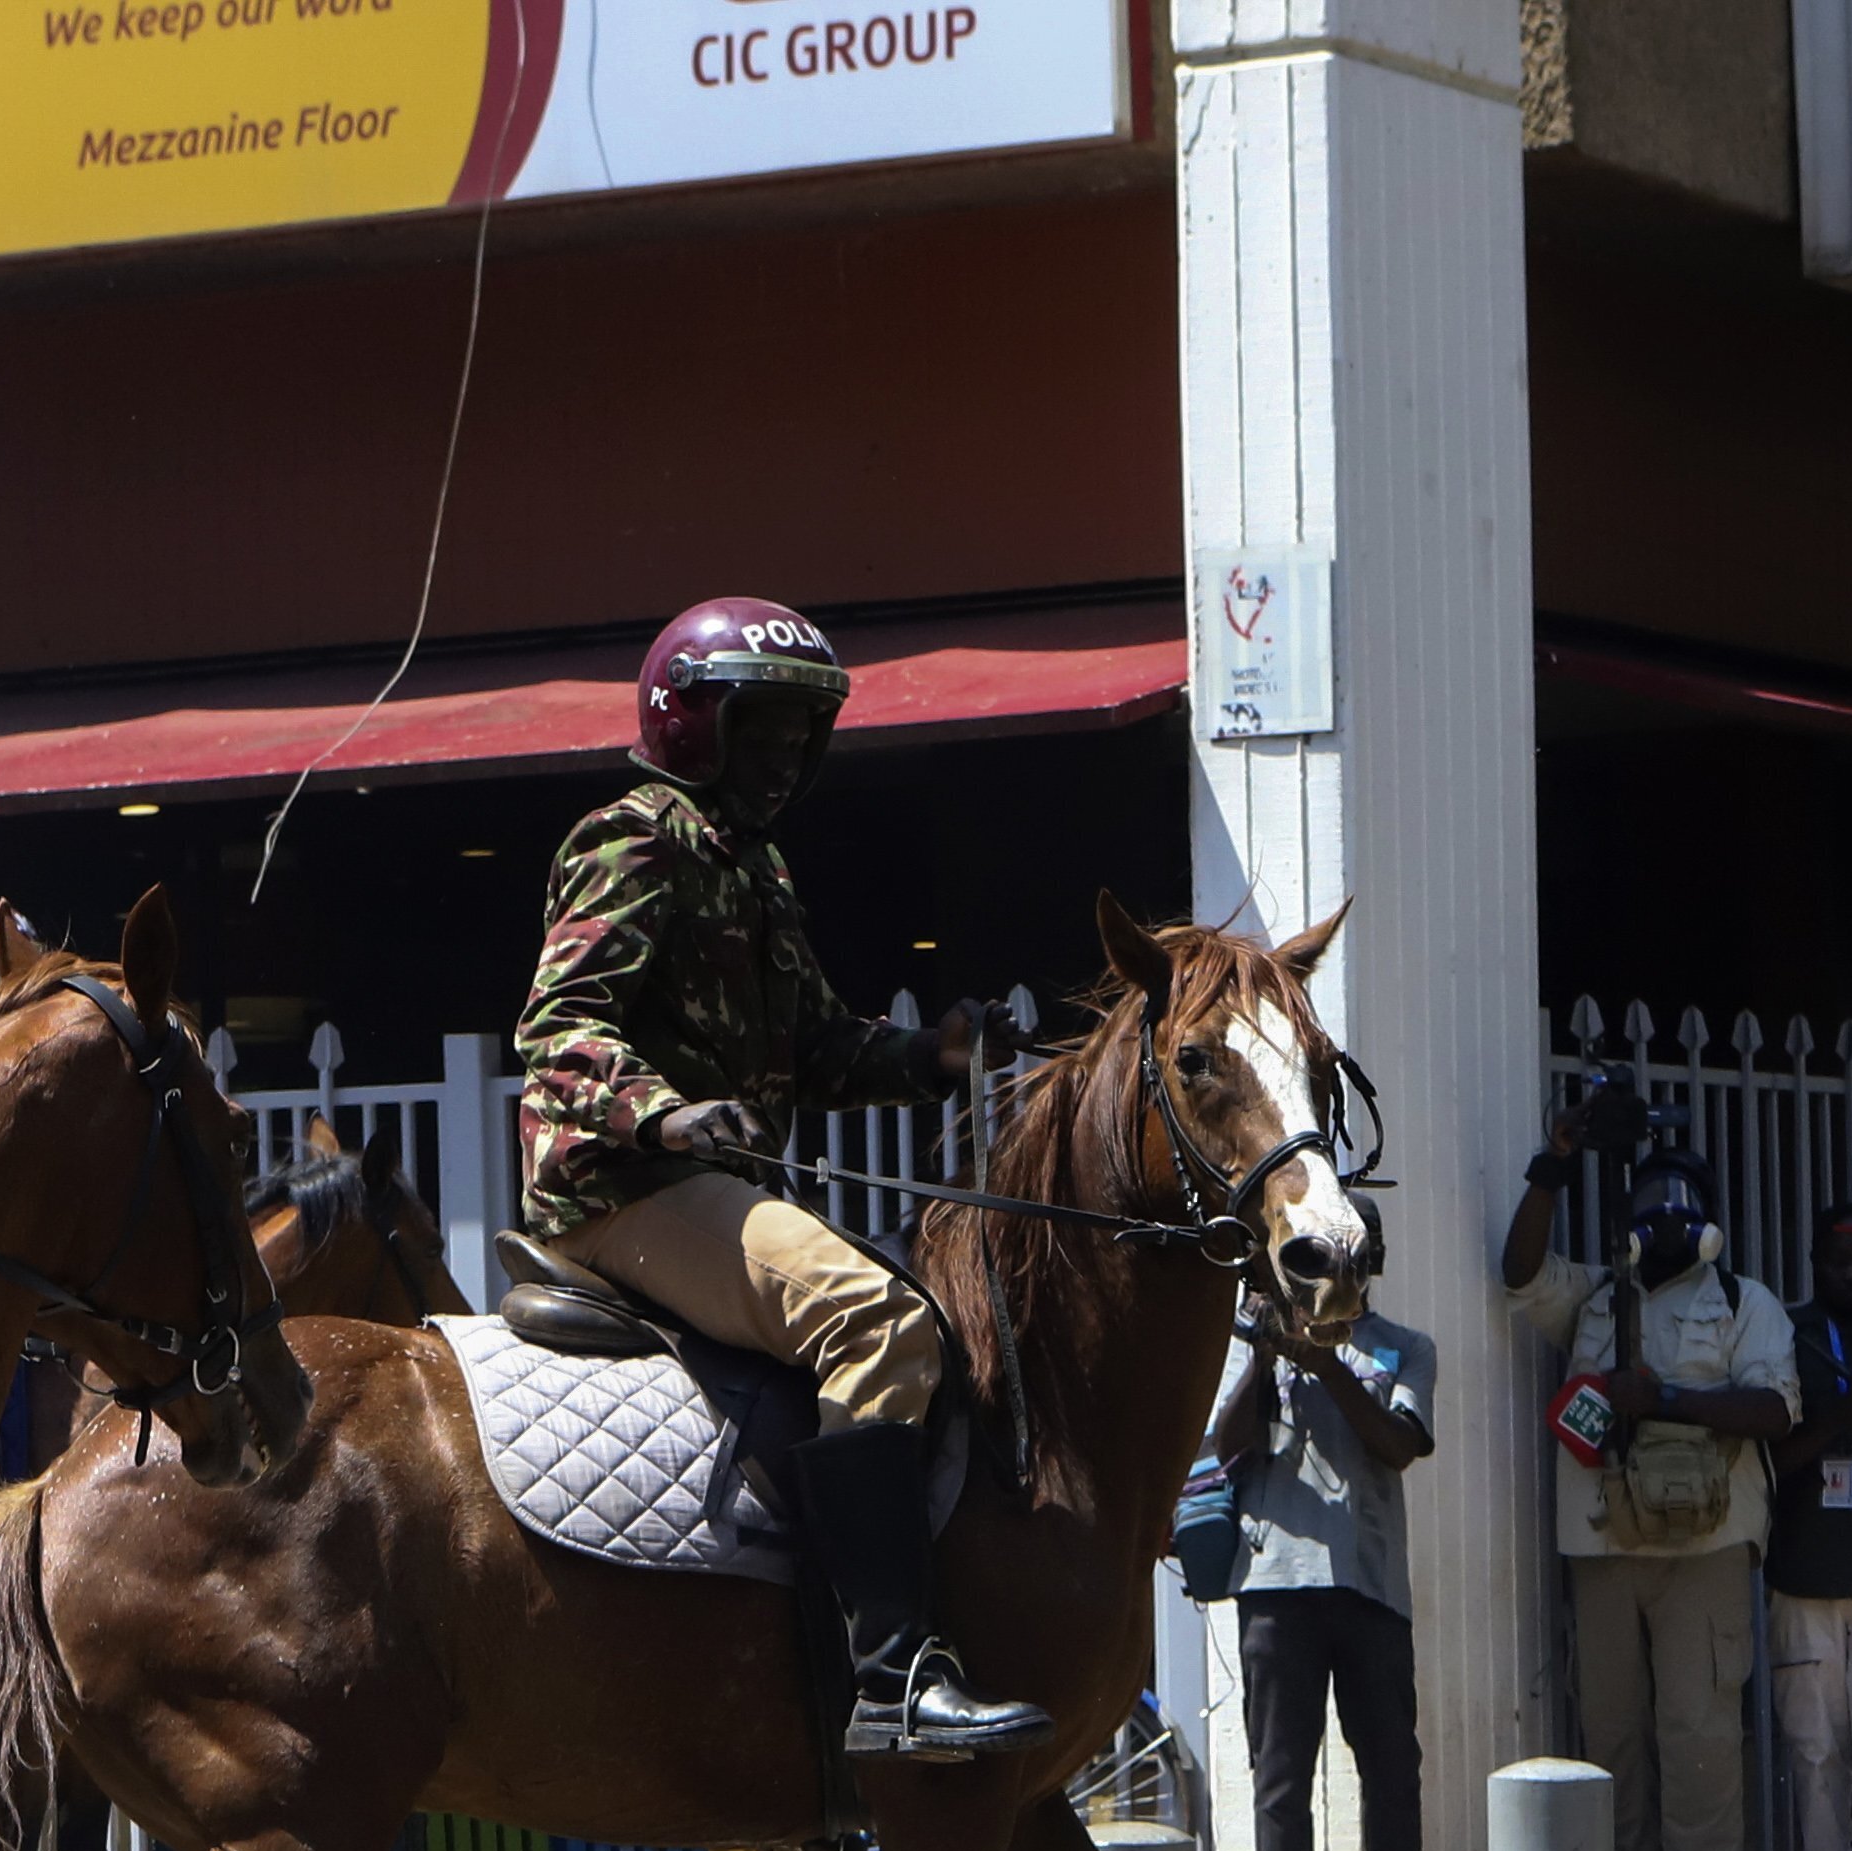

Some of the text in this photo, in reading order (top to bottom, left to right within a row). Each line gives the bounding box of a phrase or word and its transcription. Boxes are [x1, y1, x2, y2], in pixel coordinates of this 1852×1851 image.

[44, 6, 104, 48] We
[114, 0, 206, 43] keep
[215, 0, 280, 29] our
[691, 7, 978, 87] CIC GROUP
[78, 101, 399, 170] Mezzanine Floor
[650, 686, 670, 711] PC
